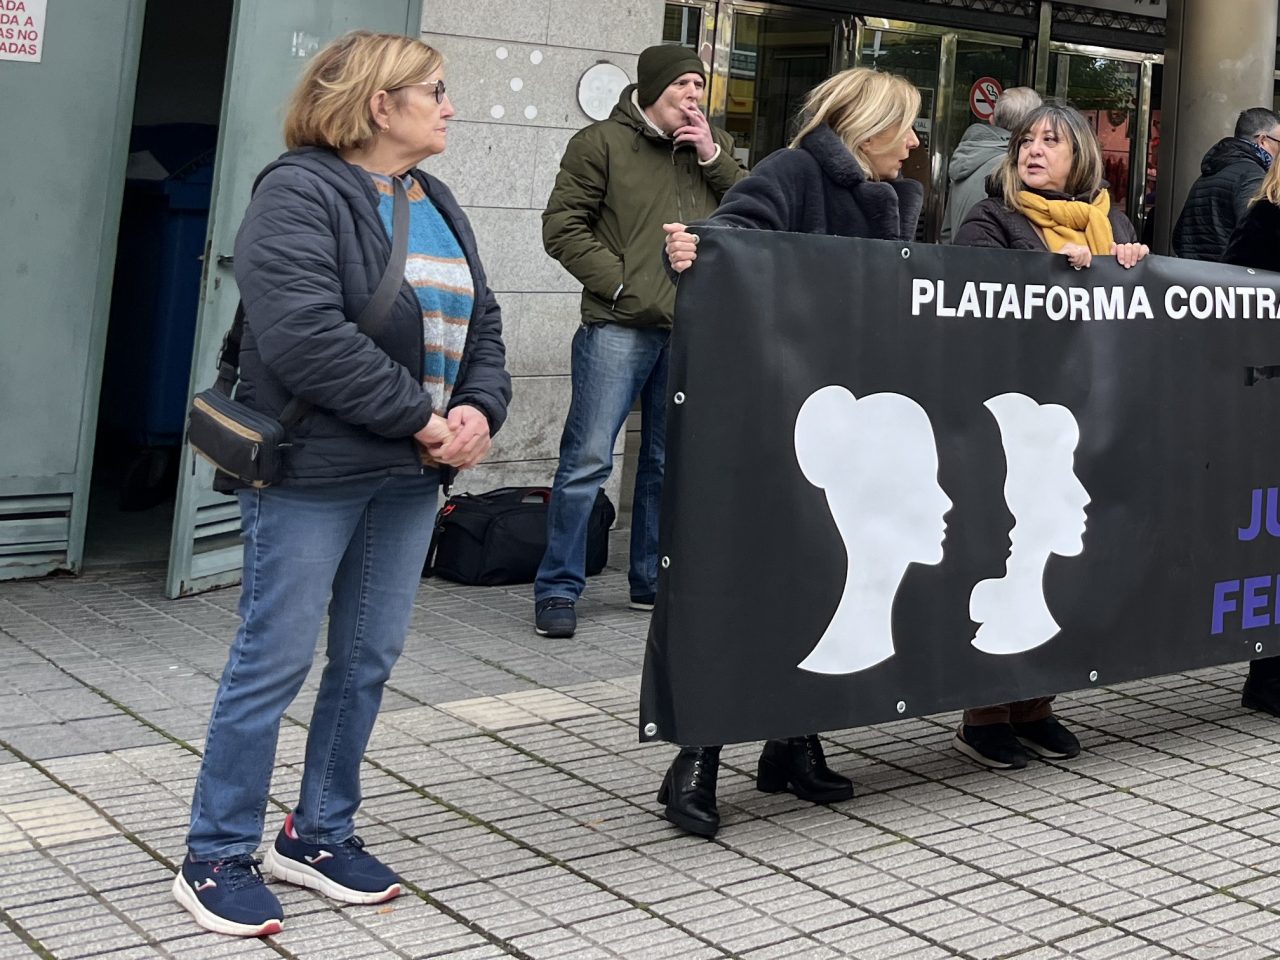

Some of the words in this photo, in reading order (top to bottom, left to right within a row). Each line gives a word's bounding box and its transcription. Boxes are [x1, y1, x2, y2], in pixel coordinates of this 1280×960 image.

[0, 14, 19, 26] DA
[24, 16, 34, 27] A
[17, 29, 38, 41] NO
[0, 42, 37, 55] ADAS
[911, 278, 1153, 321] PLATAFORMA
